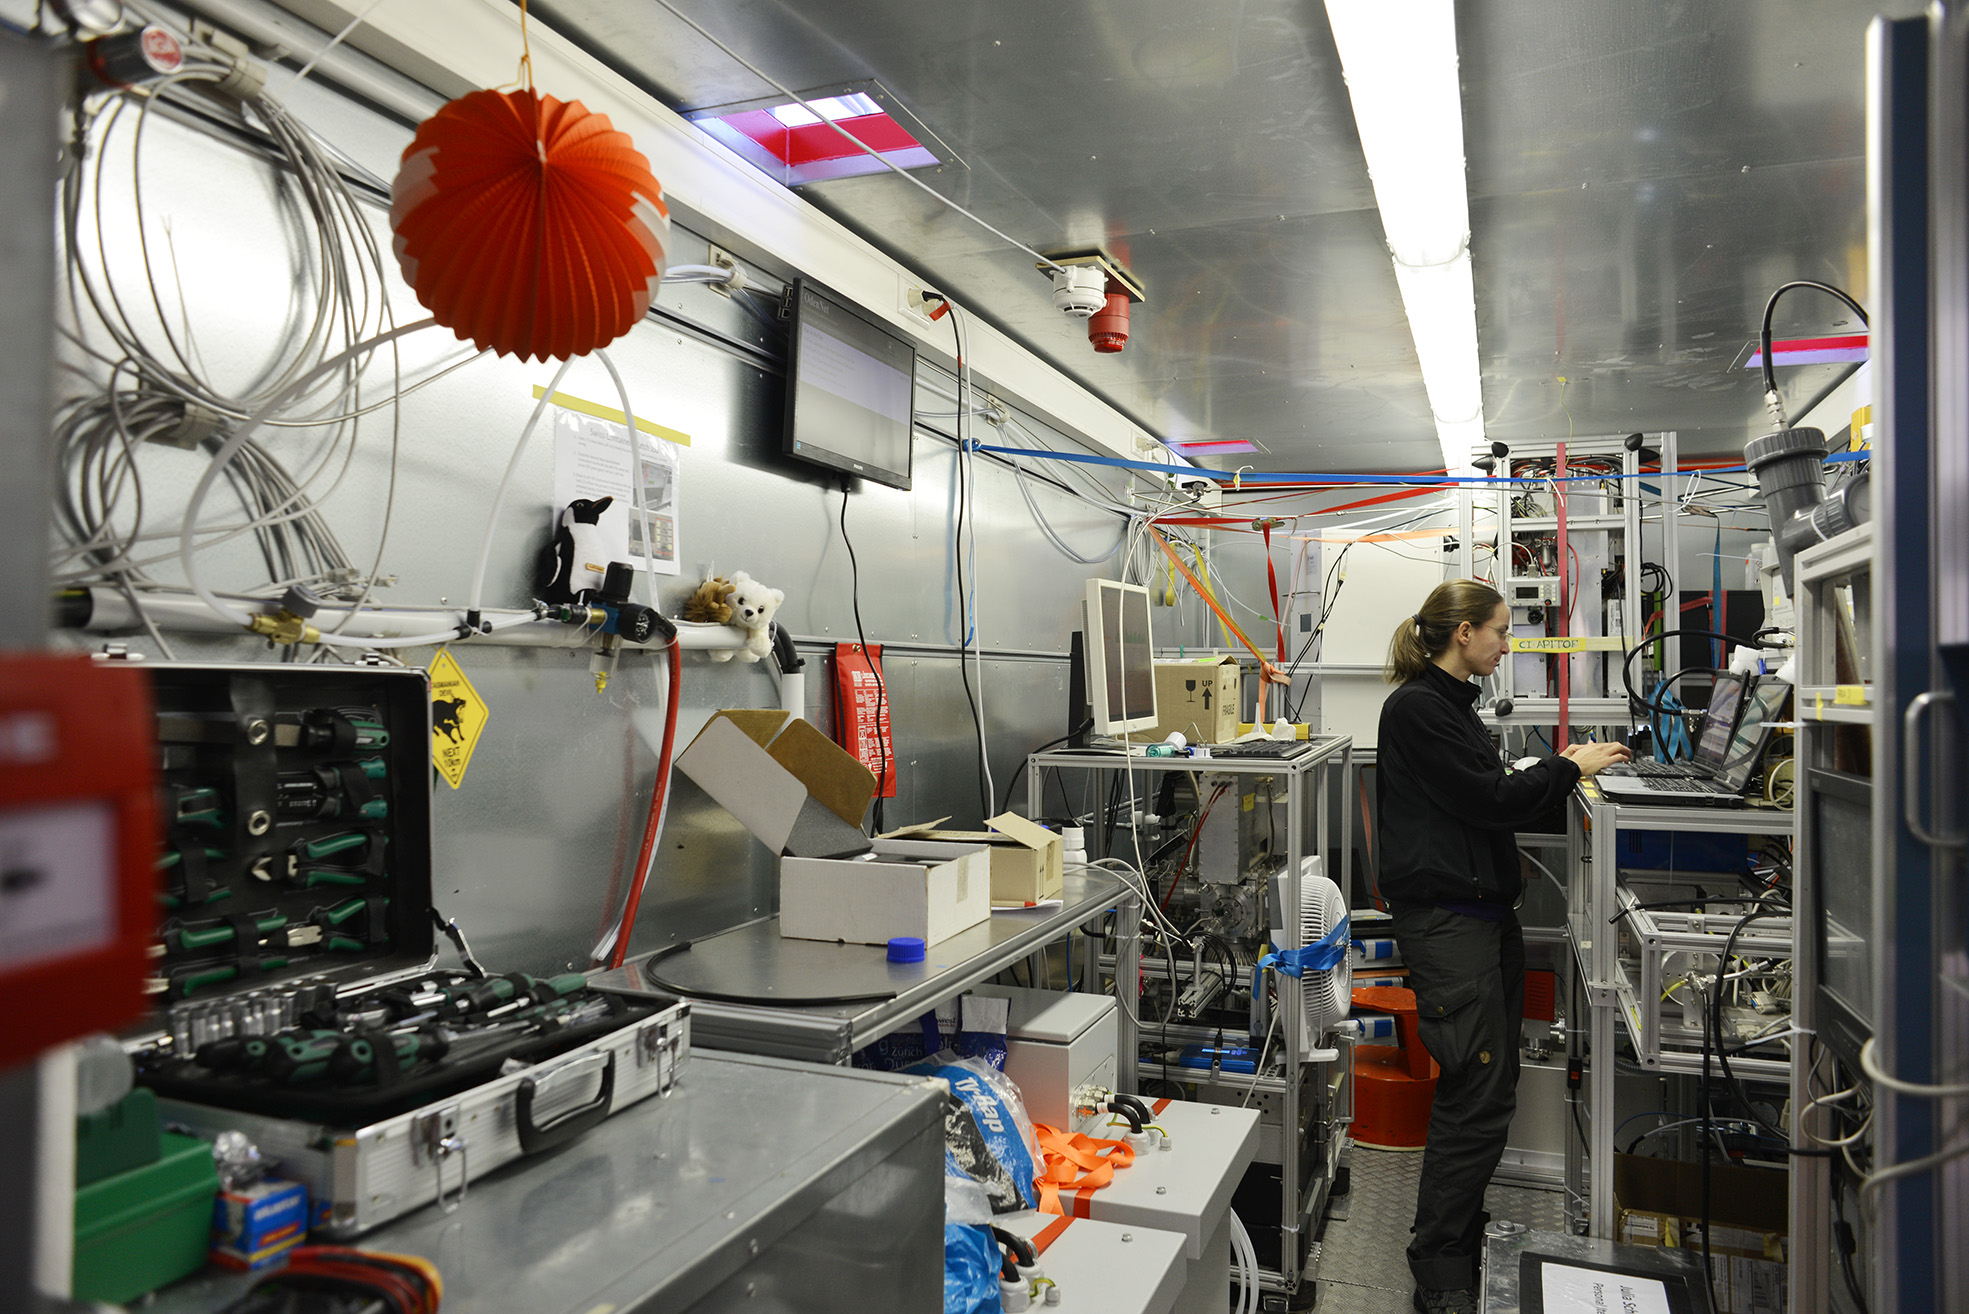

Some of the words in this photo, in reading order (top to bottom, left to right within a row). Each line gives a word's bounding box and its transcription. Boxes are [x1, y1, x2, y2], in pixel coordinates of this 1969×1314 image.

[442, 746, 460, 758] NEXT
[891, 1046, 923, 1057] Zürich
[955, 1076, 1005, 1133] Ty-Rap
[1593, 1282, 1608, 1307] Personal
[1620, 1284, 1636, 1301] Julia
